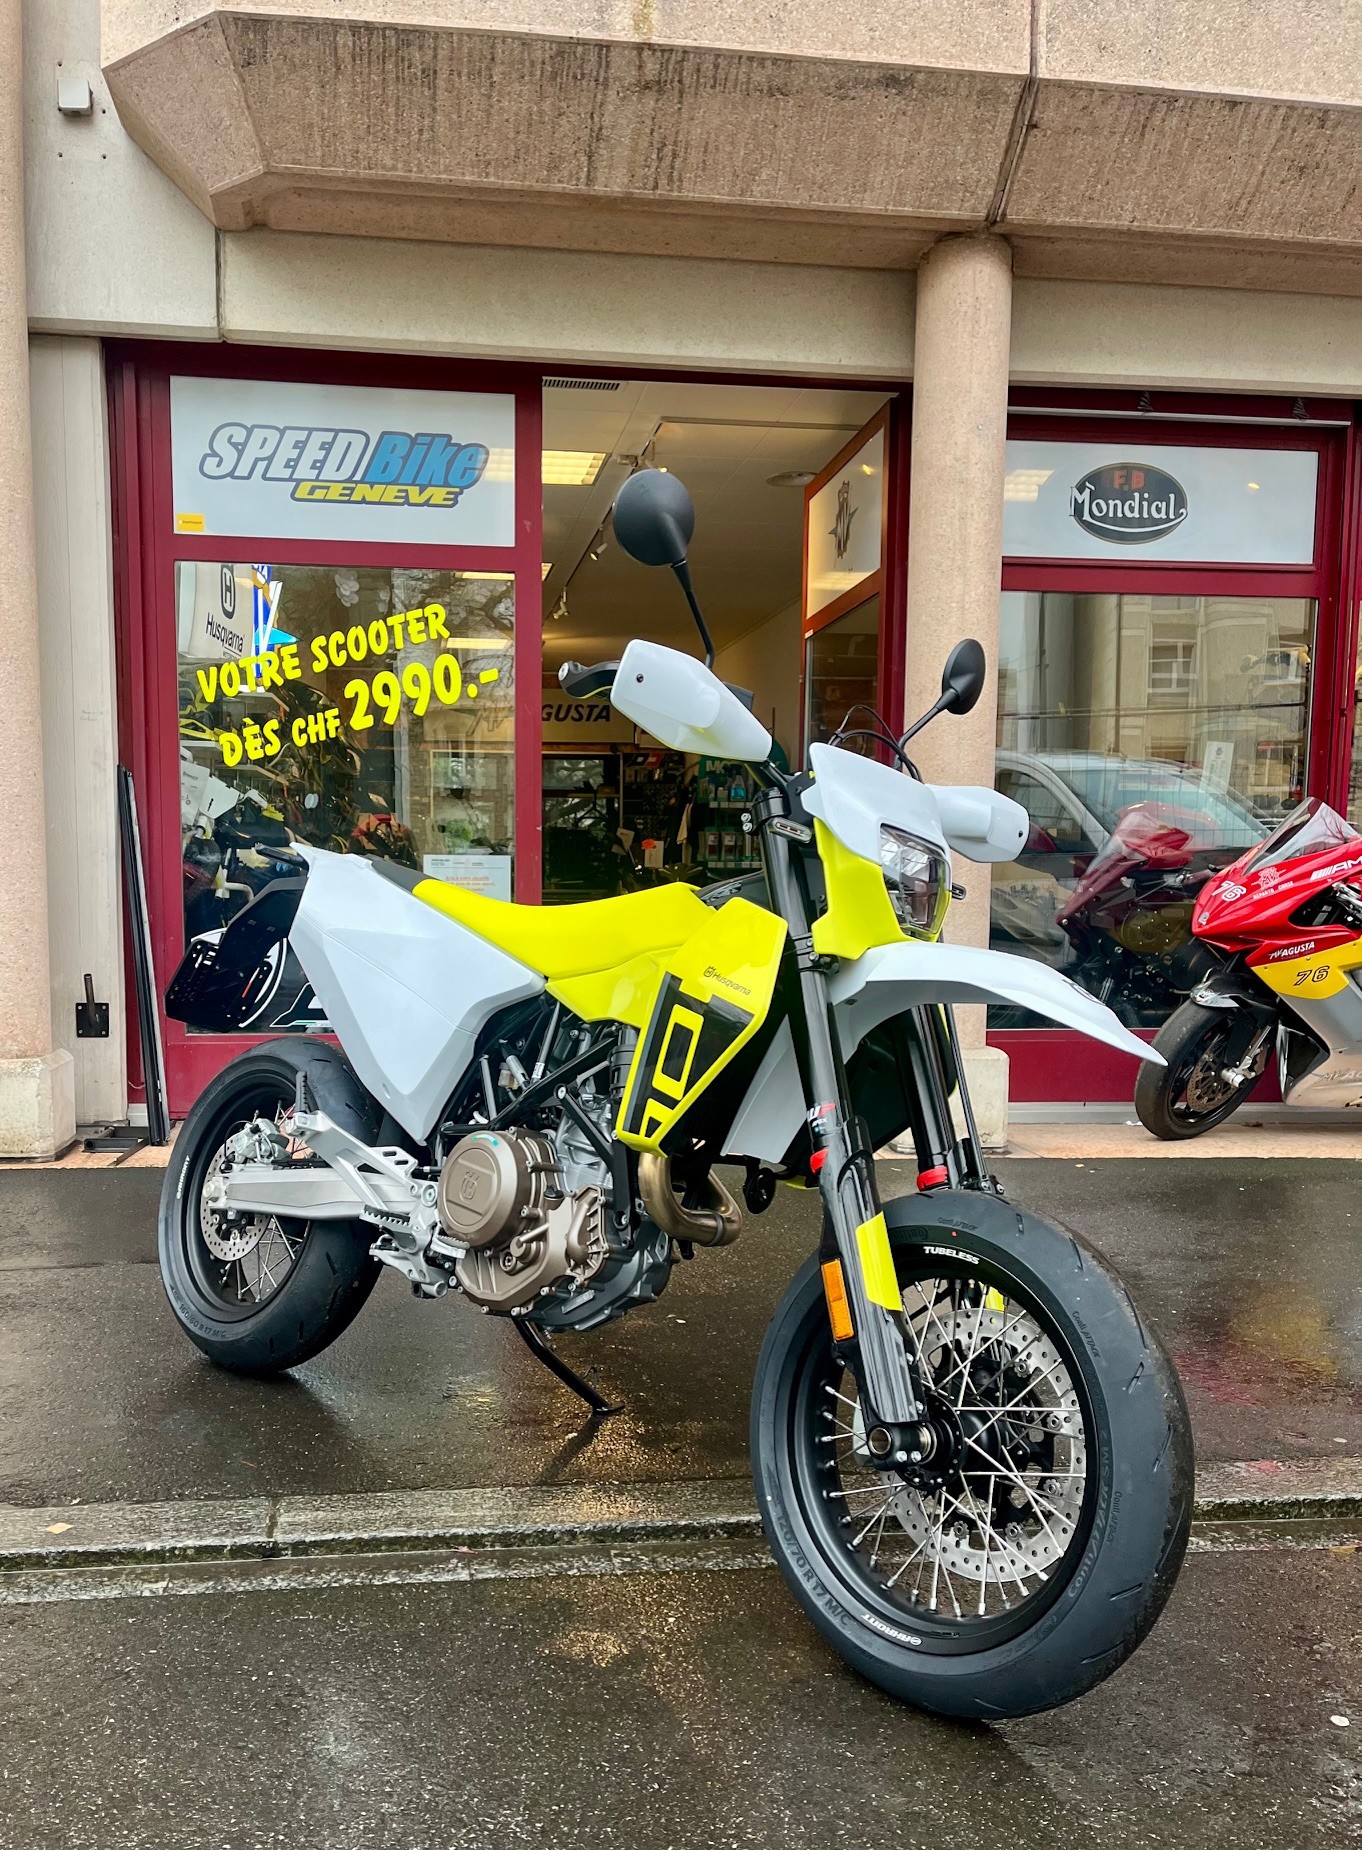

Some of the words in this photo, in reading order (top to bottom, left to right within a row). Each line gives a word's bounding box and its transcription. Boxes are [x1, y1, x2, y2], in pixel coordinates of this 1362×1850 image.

[199, 422, 370, 480] SPEED
[364, 430, 489, 489] Bike
[290, 481, 462, 508] GENEVE
[1069, 481, 1187, 529] Mondial
[205, 612, 244, 654] Husqvarna
[197, 643, 302, 703] VOTRE
[311, 602, 451, 674] SCOOTER
[218, 715, 282, 768] DÈS
[291, 707, 342, 748] CHF
[343, 653, 500, 732] 2990.-
[1211, 880, 1247, 902] 76
[1281, 941, 1316, 957] AGUSTA
[712, 972, 752, 996] Husqvarna
[1293, 965, 1331, 987] 76
[923, 1246, 980, 1265] TUBELESS
